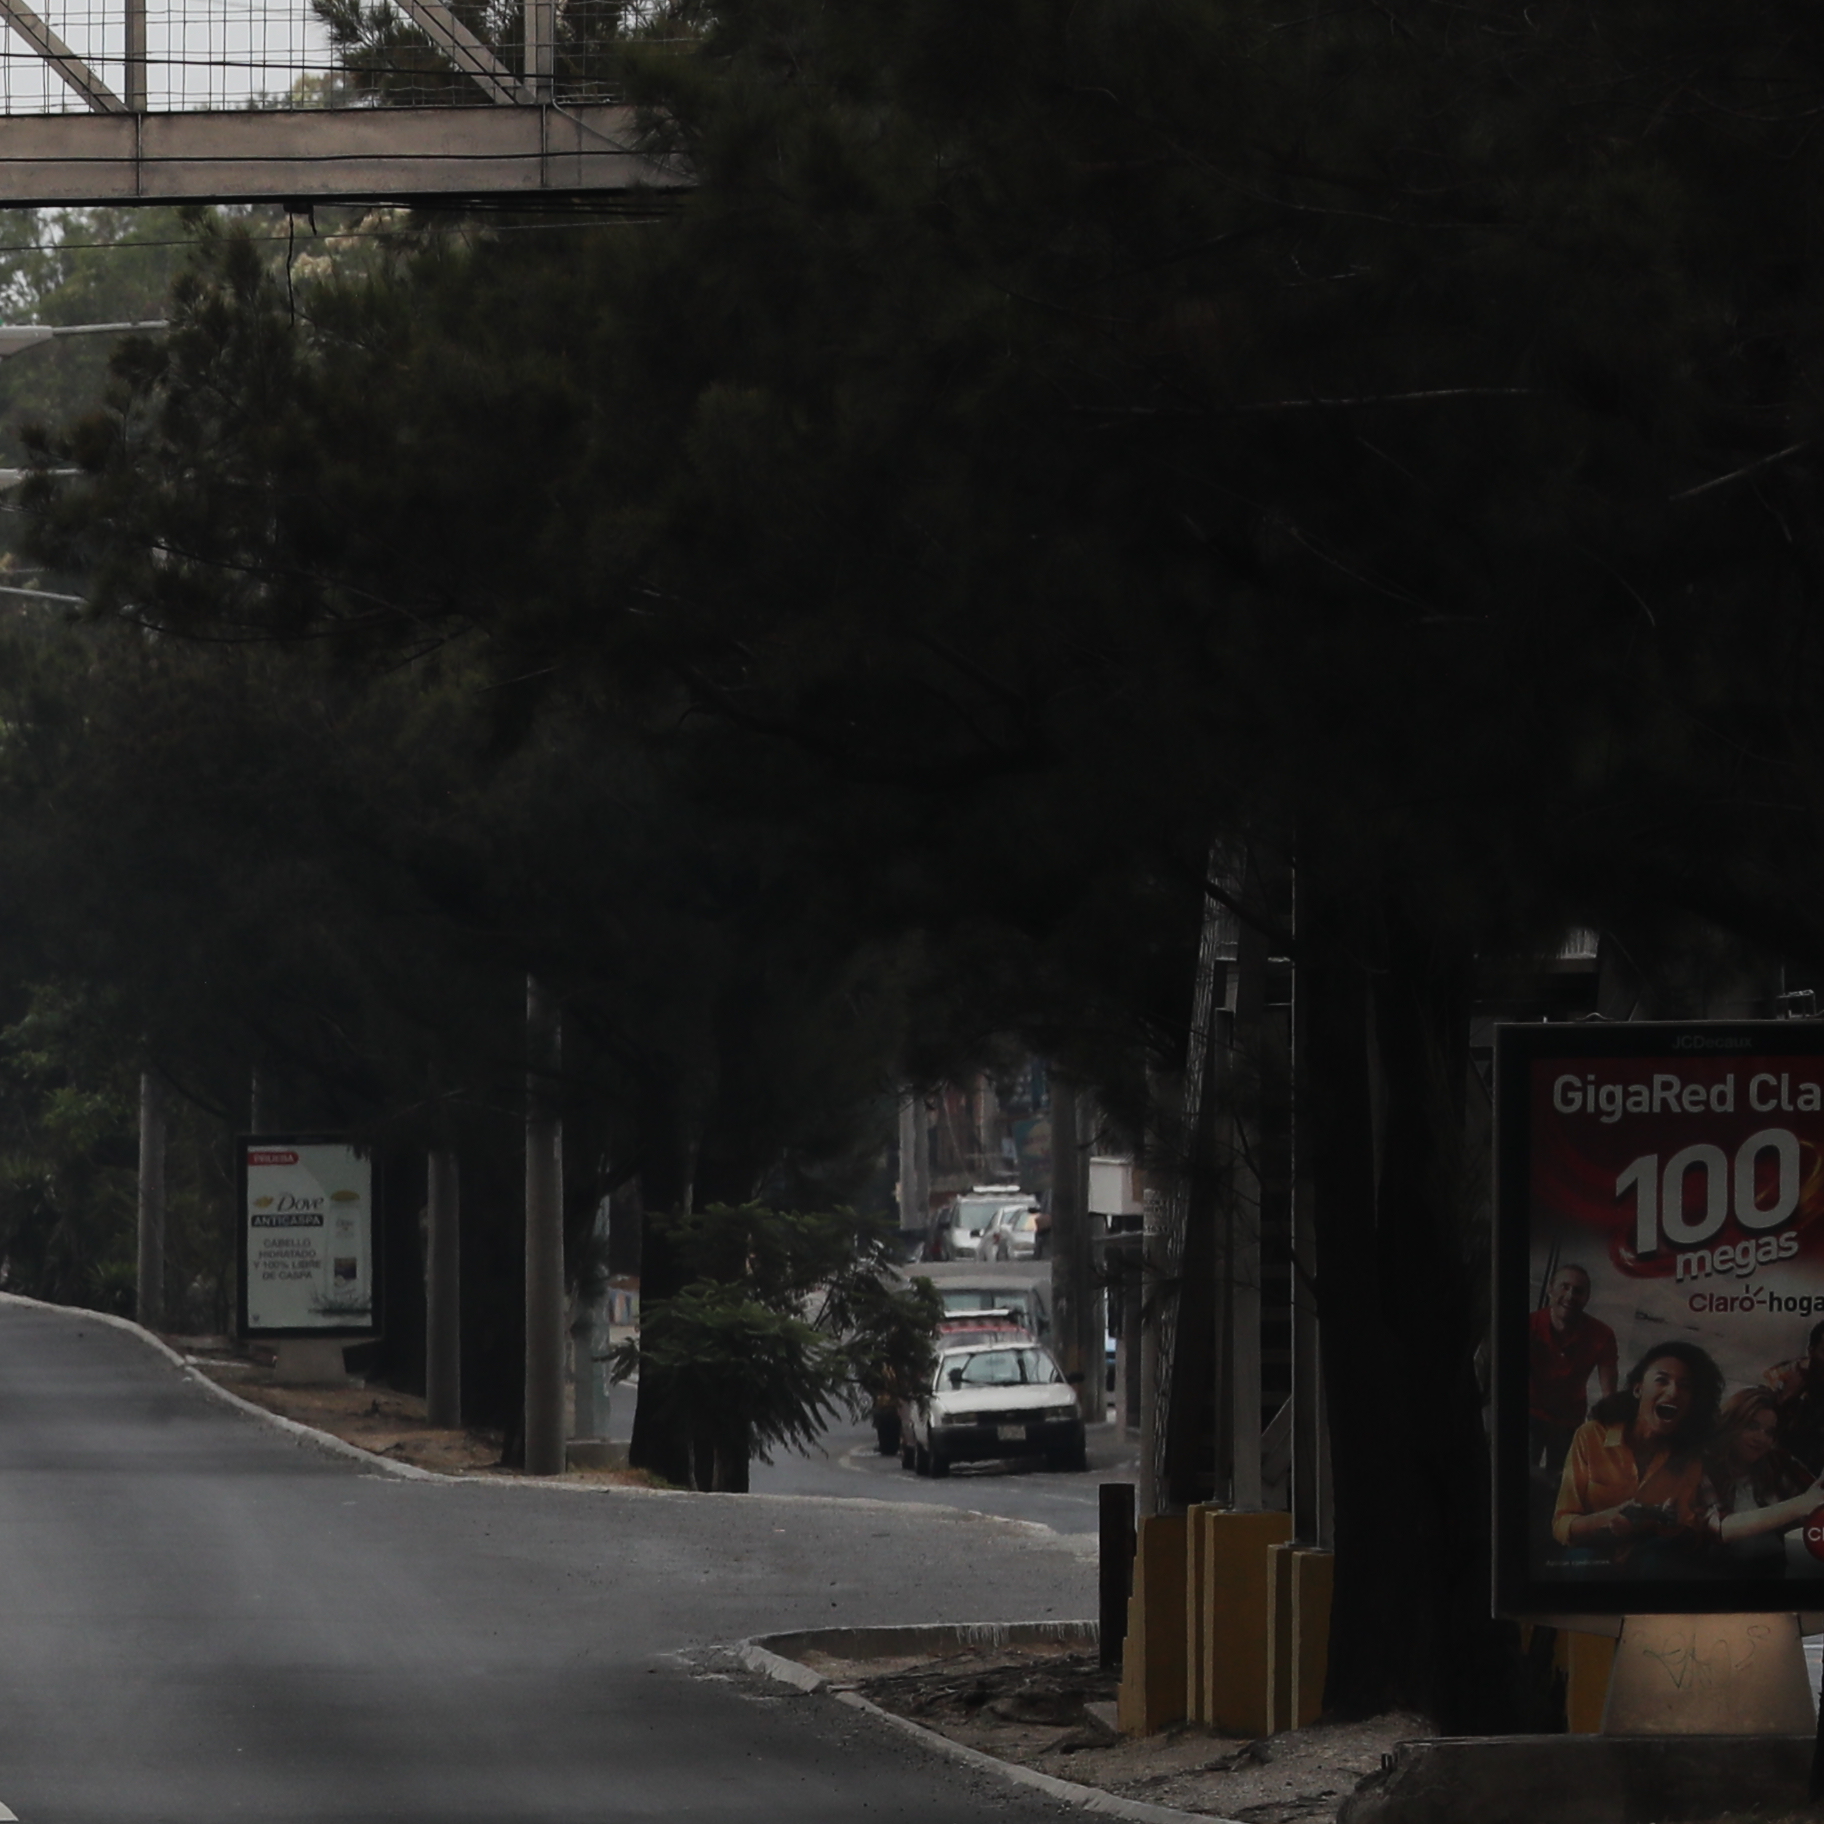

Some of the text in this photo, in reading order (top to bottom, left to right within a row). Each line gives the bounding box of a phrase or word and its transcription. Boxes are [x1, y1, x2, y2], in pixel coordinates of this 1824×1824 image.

[1672, 1035, 1752, 1048] JCDecaux
[1553, 1073, 1822, 1124] GigaRed Cla
[277, 1190, 324, 1213] Dove
[1615, 1127, 1801, 1254] 100
[254, 1214, 321, 1227] ANTICASPA
[263, 1238, 311, 1249] CABELLO
[1676, 1230, 1800, 1281] megas
